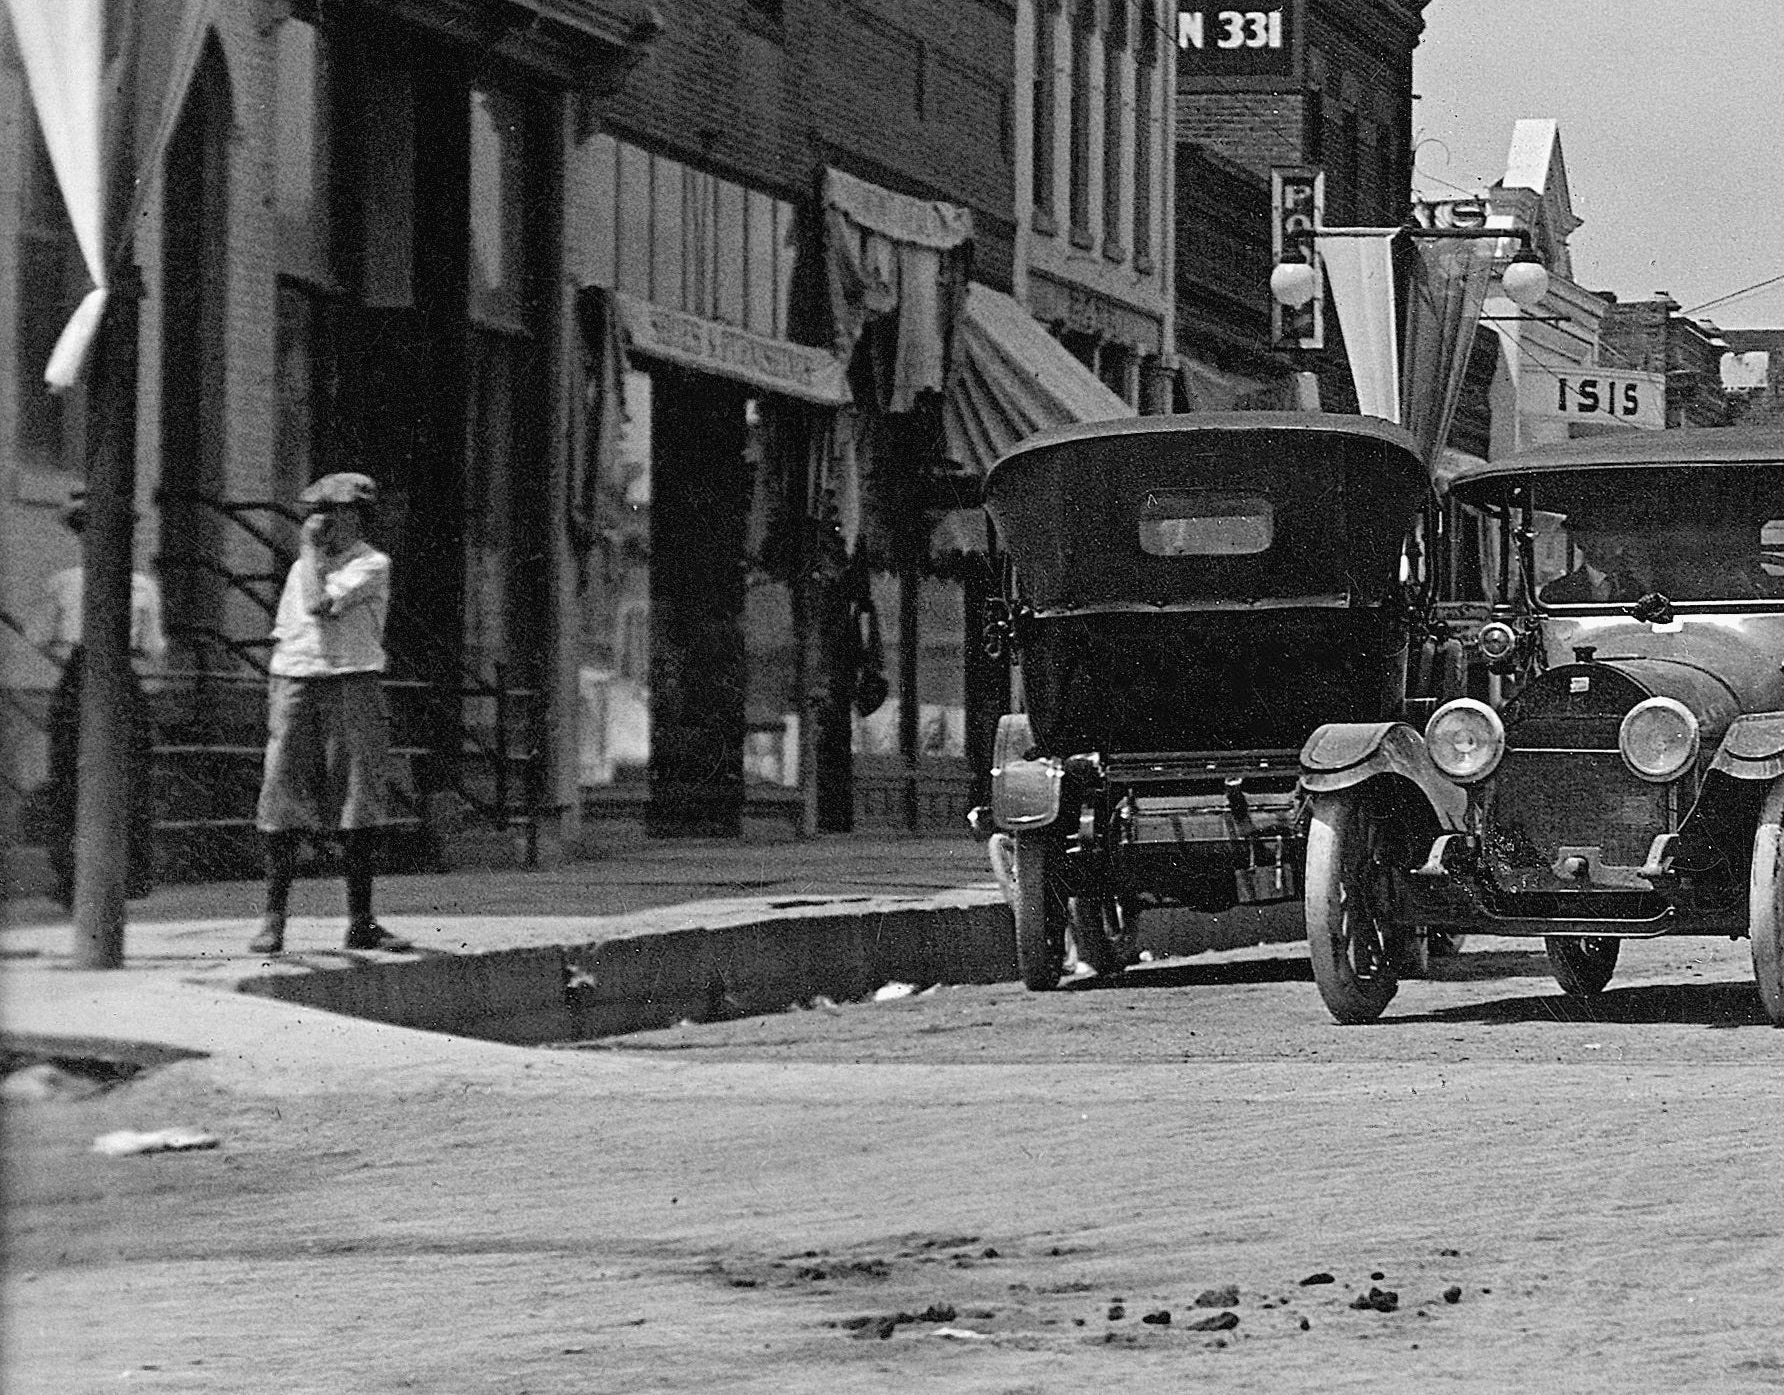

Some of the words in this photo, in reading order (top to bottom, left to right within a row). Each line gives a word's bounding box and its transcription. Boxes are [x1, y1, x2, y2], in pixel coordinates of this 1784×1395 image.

[1178, 12, 1203, 48] N
[1217, 11, 1282, 48] 331
[1557, 377, 1638, 416] ISIS
